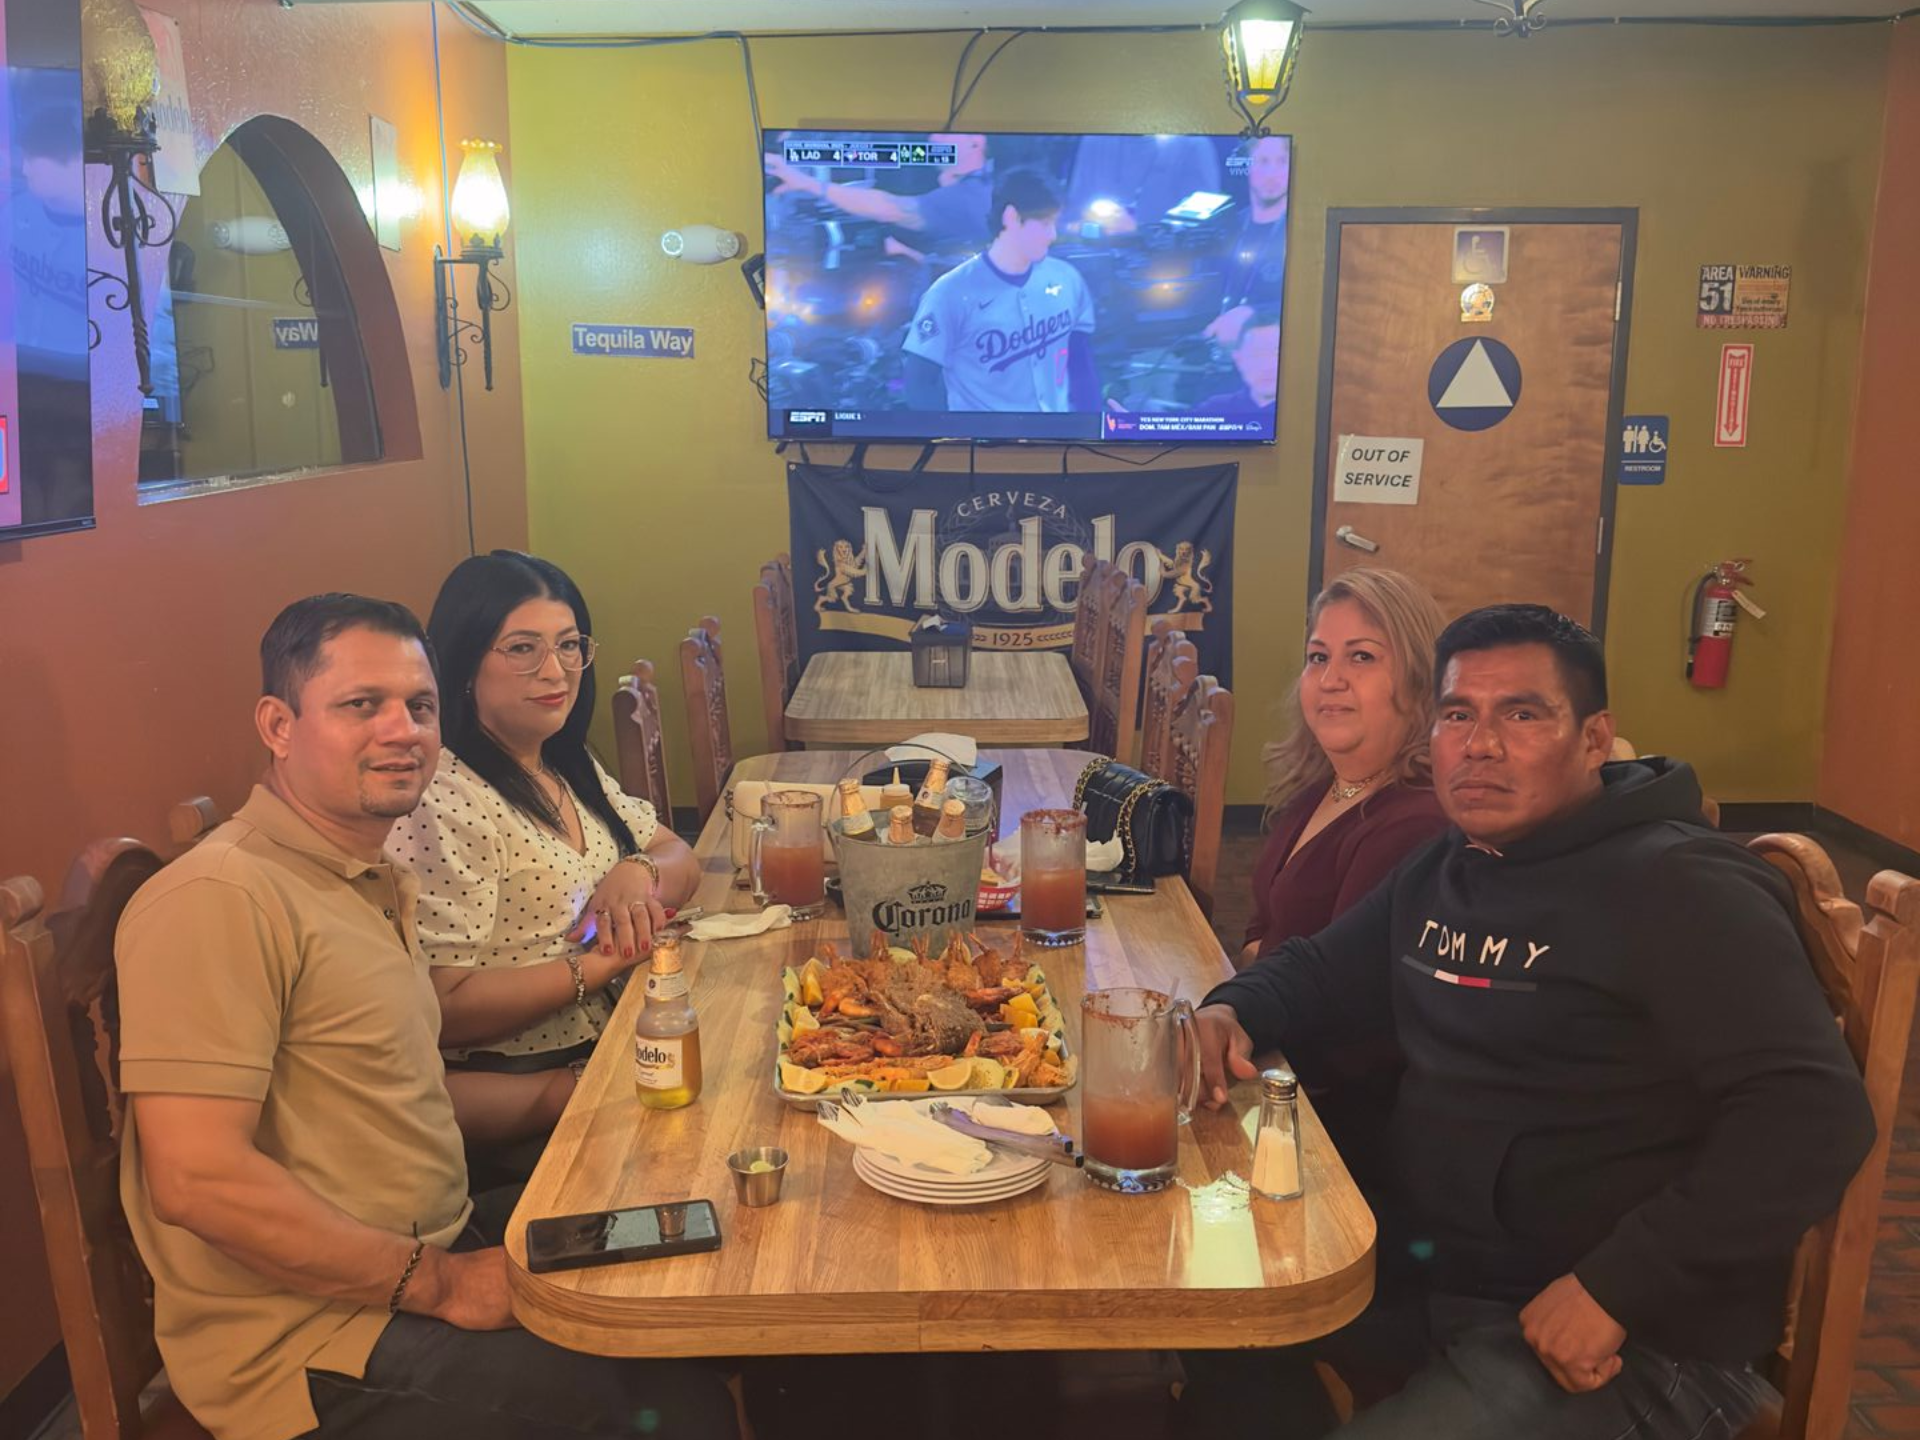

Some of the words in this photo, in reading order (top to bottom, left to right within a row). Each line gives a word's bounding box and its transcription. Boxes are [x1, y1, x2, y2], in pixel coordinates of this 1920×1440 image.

[801, 152, 821, 161] LAD
[832, 152, 841, 161] 4
[858, 152, 878, 161] TOR
[890, 152, 898, 162] 4
[1702, 266, 1733, 280] AREA
[1739, 266, 1789, 279] WARNING
[1700, 282, 1733, 311] 51
[574, 327, 646, 352] Tequila
[650, 330, 693, 355] Way
[976, 308, 1072, 364] Dodgers
[790, 411, 826, 422] ESPN
[1351, 448, 1385, 462] OUT
[1387, 450, 1411, 463] OF
[1344, 472, 1413, 488] SERVICE
[956, 491, 1067, 520] CERVEZA
[861, 506, 1164, 614] Modelo
[992, 632, 1034, 647] 1925
[872, 898, 971, 938] Corona
[1418, 919, 1551, 969] TOMMY
